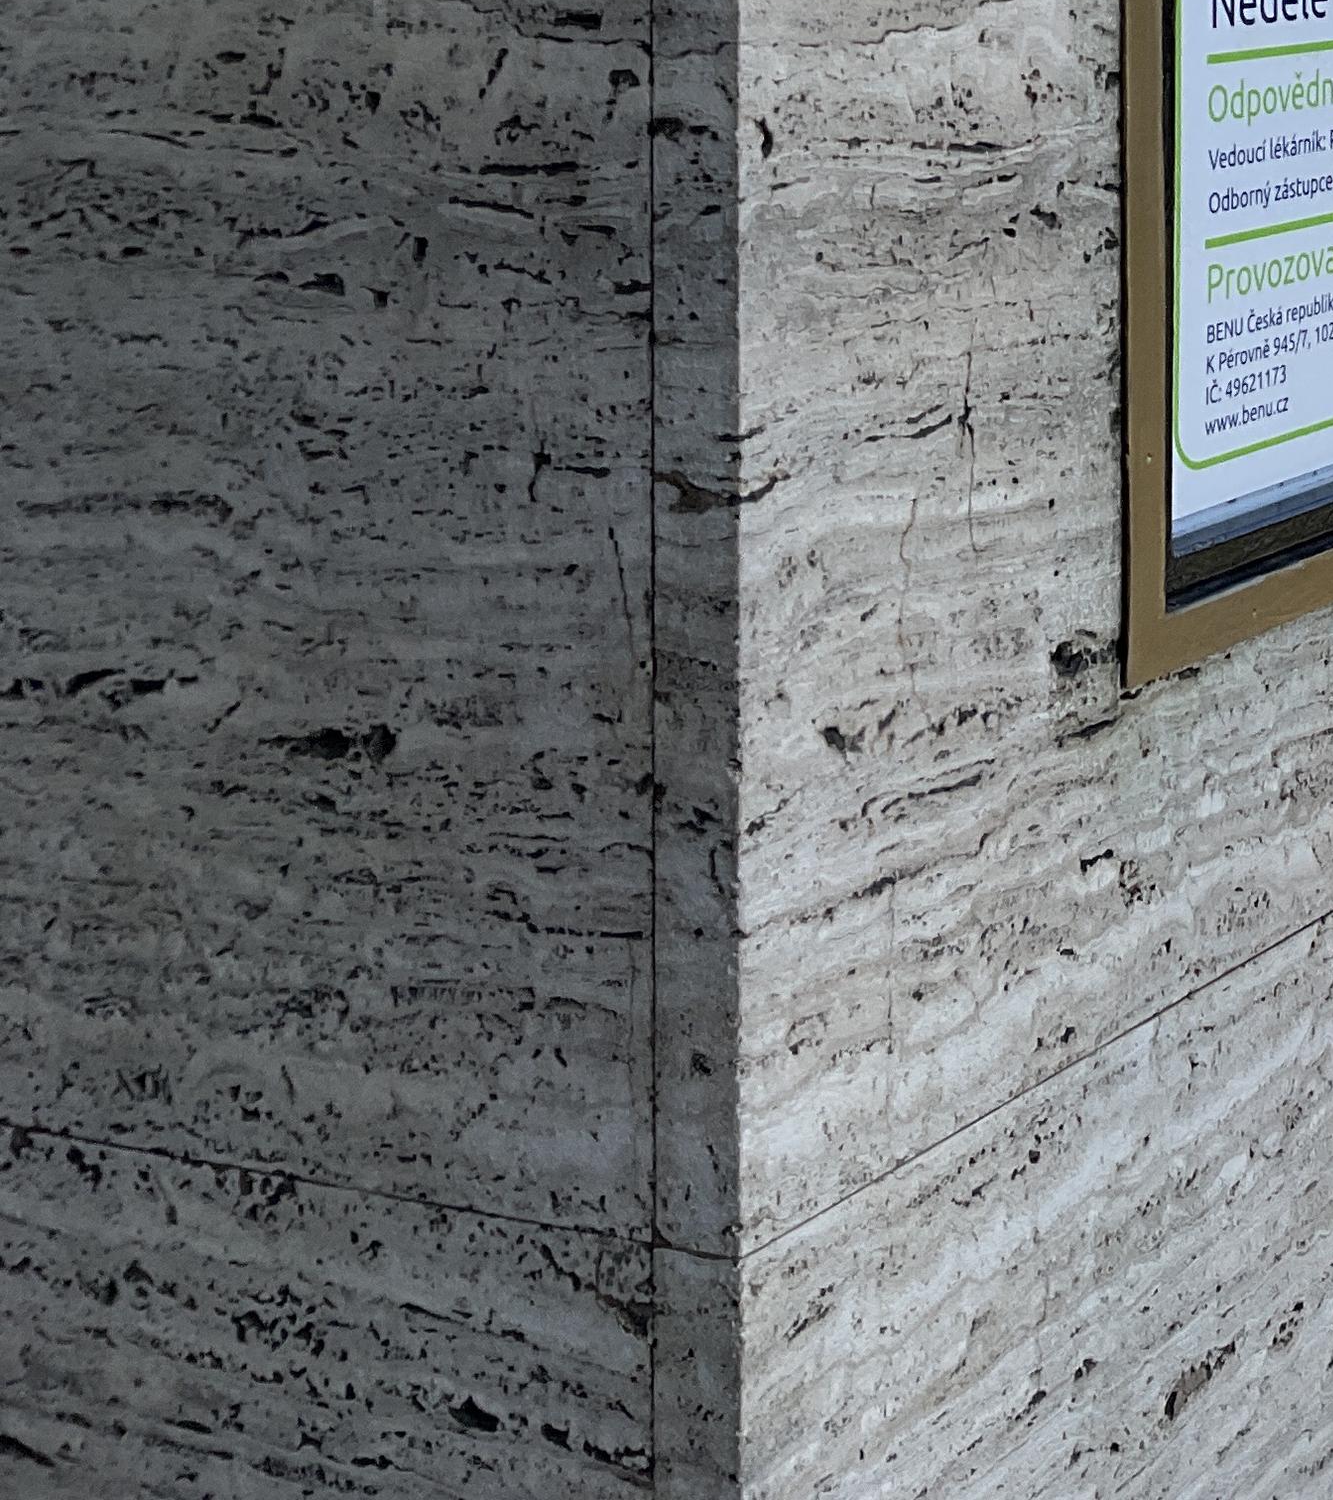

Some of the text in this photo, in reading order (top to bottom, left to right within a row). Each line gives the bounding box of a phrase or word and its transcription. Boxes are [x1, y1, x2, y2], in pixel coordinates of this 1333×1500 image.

[1208, 138, 1267, 171] Vedoucí
[1269, 129, 1326, 161] lékárník:
[1208, 180, 1272, 214] Odborný
[1206, 317, 1244, 345] BENU
[1247, 308, 1284, 333] Česká
[1205, 354, 1216, 375] K
[1218, 338, 1271, 372] Pérovně
[1273, 328, 1312, 357] 945/7,
[1204, 364, 1288, 405] IČ: 49621173
[1204, 396, 1290, 435] www.benu.cz
